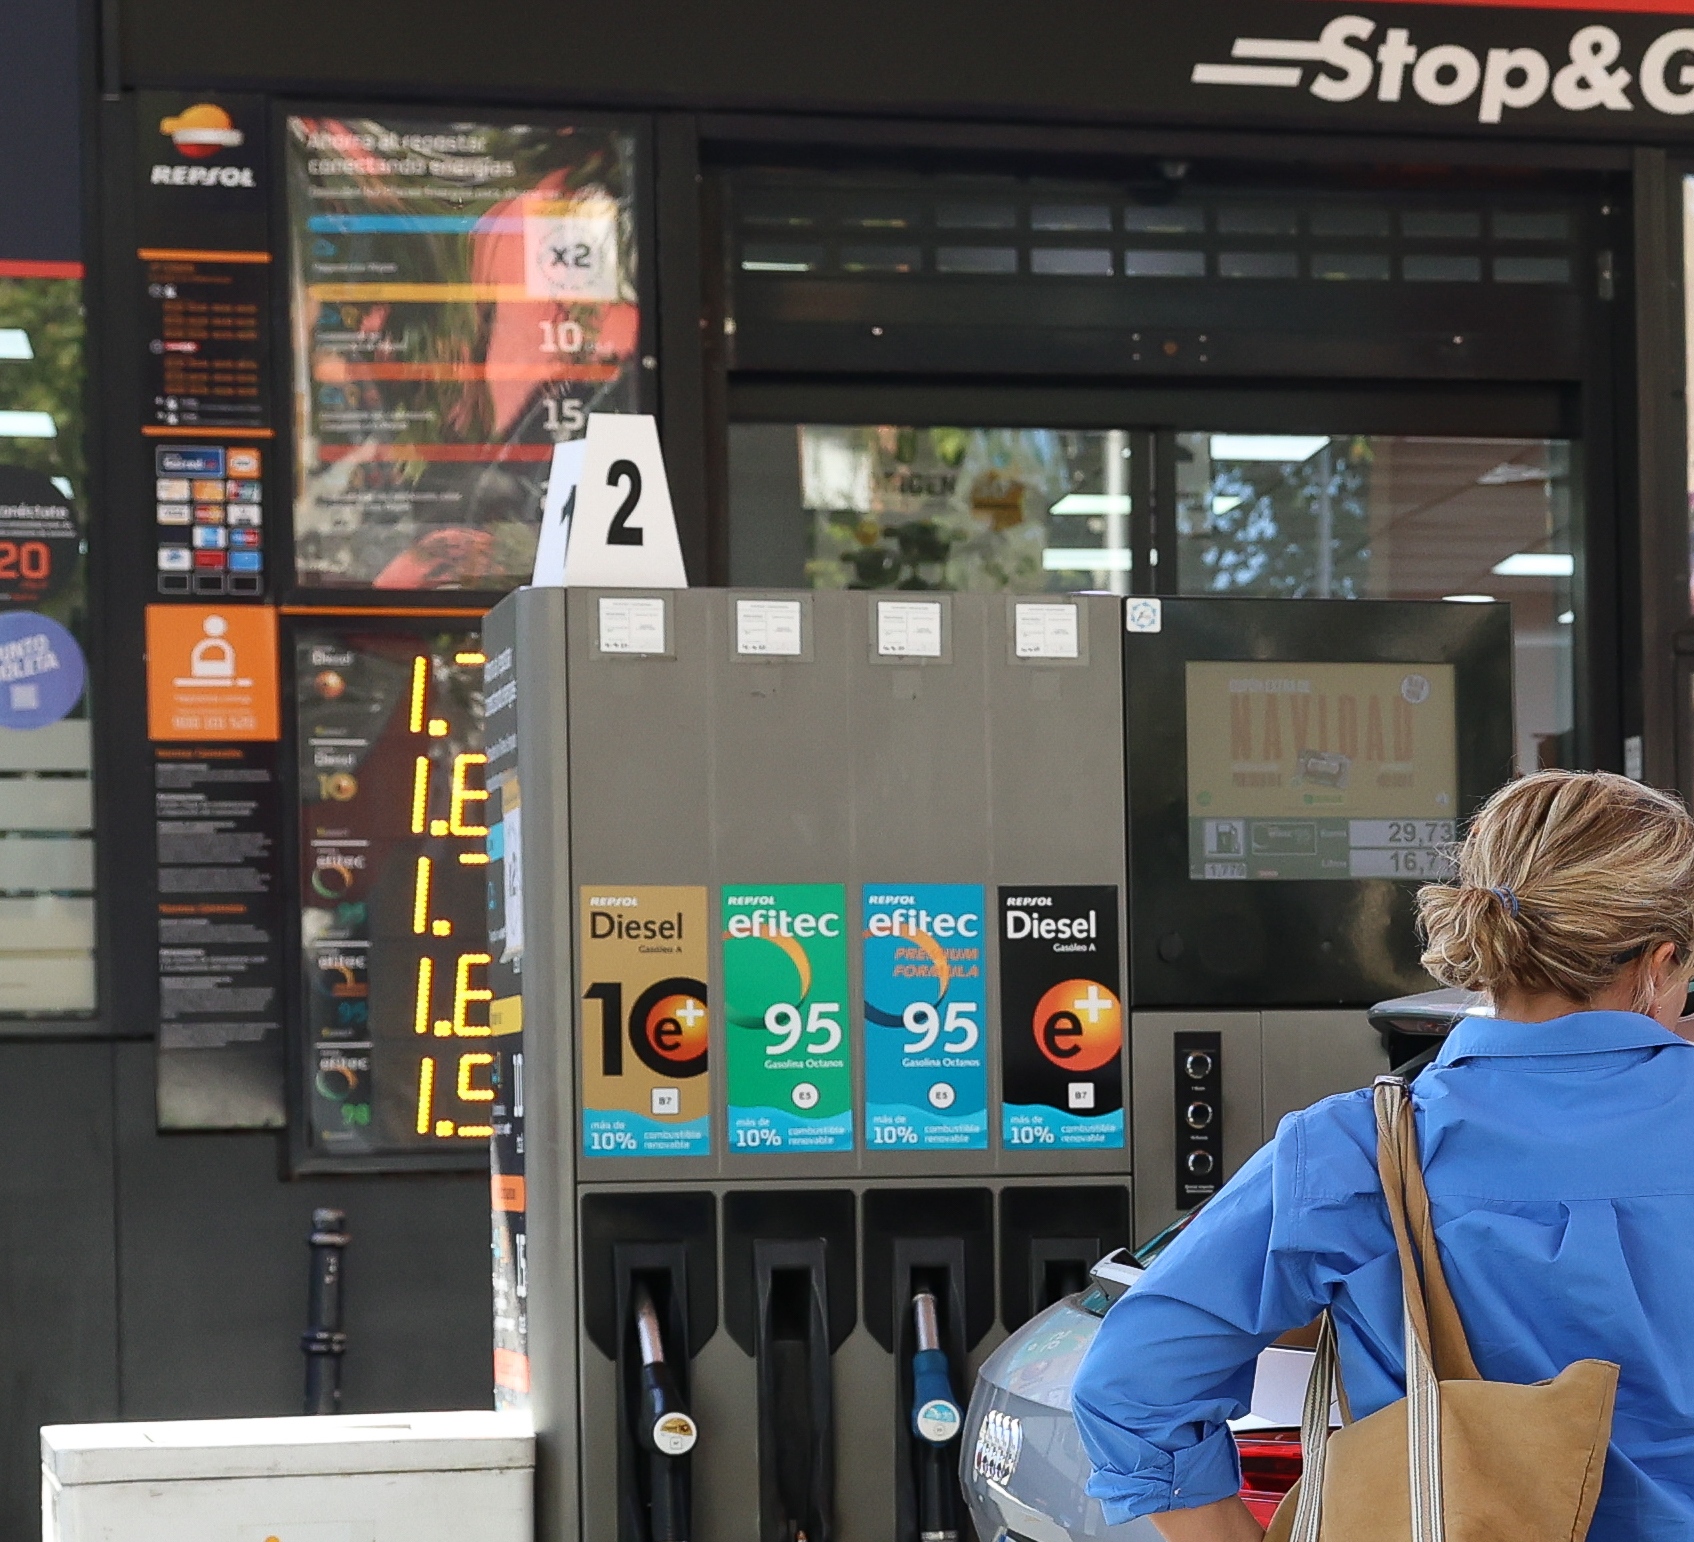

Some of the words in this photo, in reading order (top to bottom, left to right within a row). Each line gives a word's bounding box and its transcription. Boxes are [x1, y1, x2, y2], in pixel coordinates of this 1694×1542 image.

[150, 165, 256, 189] REPSOL
[551, 243, 591, 268] x2
[539, 320, 584, 354] 10
[543, 398, 586, 431] 15
[605, 459, 644, 547] 2
[1229, 692, 1414, 762] NAVIDAD
[1388, 821, 1454, 847] 29,73
[589, 896, 638, 907] REPSOL
[727, 896, 775, 906] REPSOL
[868, 895, 916, 905] REPSOL
[1006, 896, 1053, 907] REPSOL
[590, 911, 683, 940] Diesel
[728, 909, 840, 938] efitec
[868, 908, 979, 938] efitec
[1006, 909, 1097, 939] Diesel
[894, 948, 979, 960] PREIUM
[1053, 942, 1087, 953] Gasóleo
[1088, 943, 1096, 952] A
[763, 1002, 843, 1056] 95
[902, 1001, 979, 1054] 95
[764, 1058, 804, 1070] Gasolina
[805, 1058, 844, 1069] Octanos
[902, 1057, 941, 1068] Gasolina
[942, 1057, 981, 1068] Octanos
[935, 1091, 948, 1100] E5
[1074, 1091, 1088, 1100] B7
[590, 1131, 638, 1151] 10%
[735, 1128, 782, 1147] 10%
[873, 1126, 919, 1145] 10%
[1010, 1126, 1055, 1145] 10%
